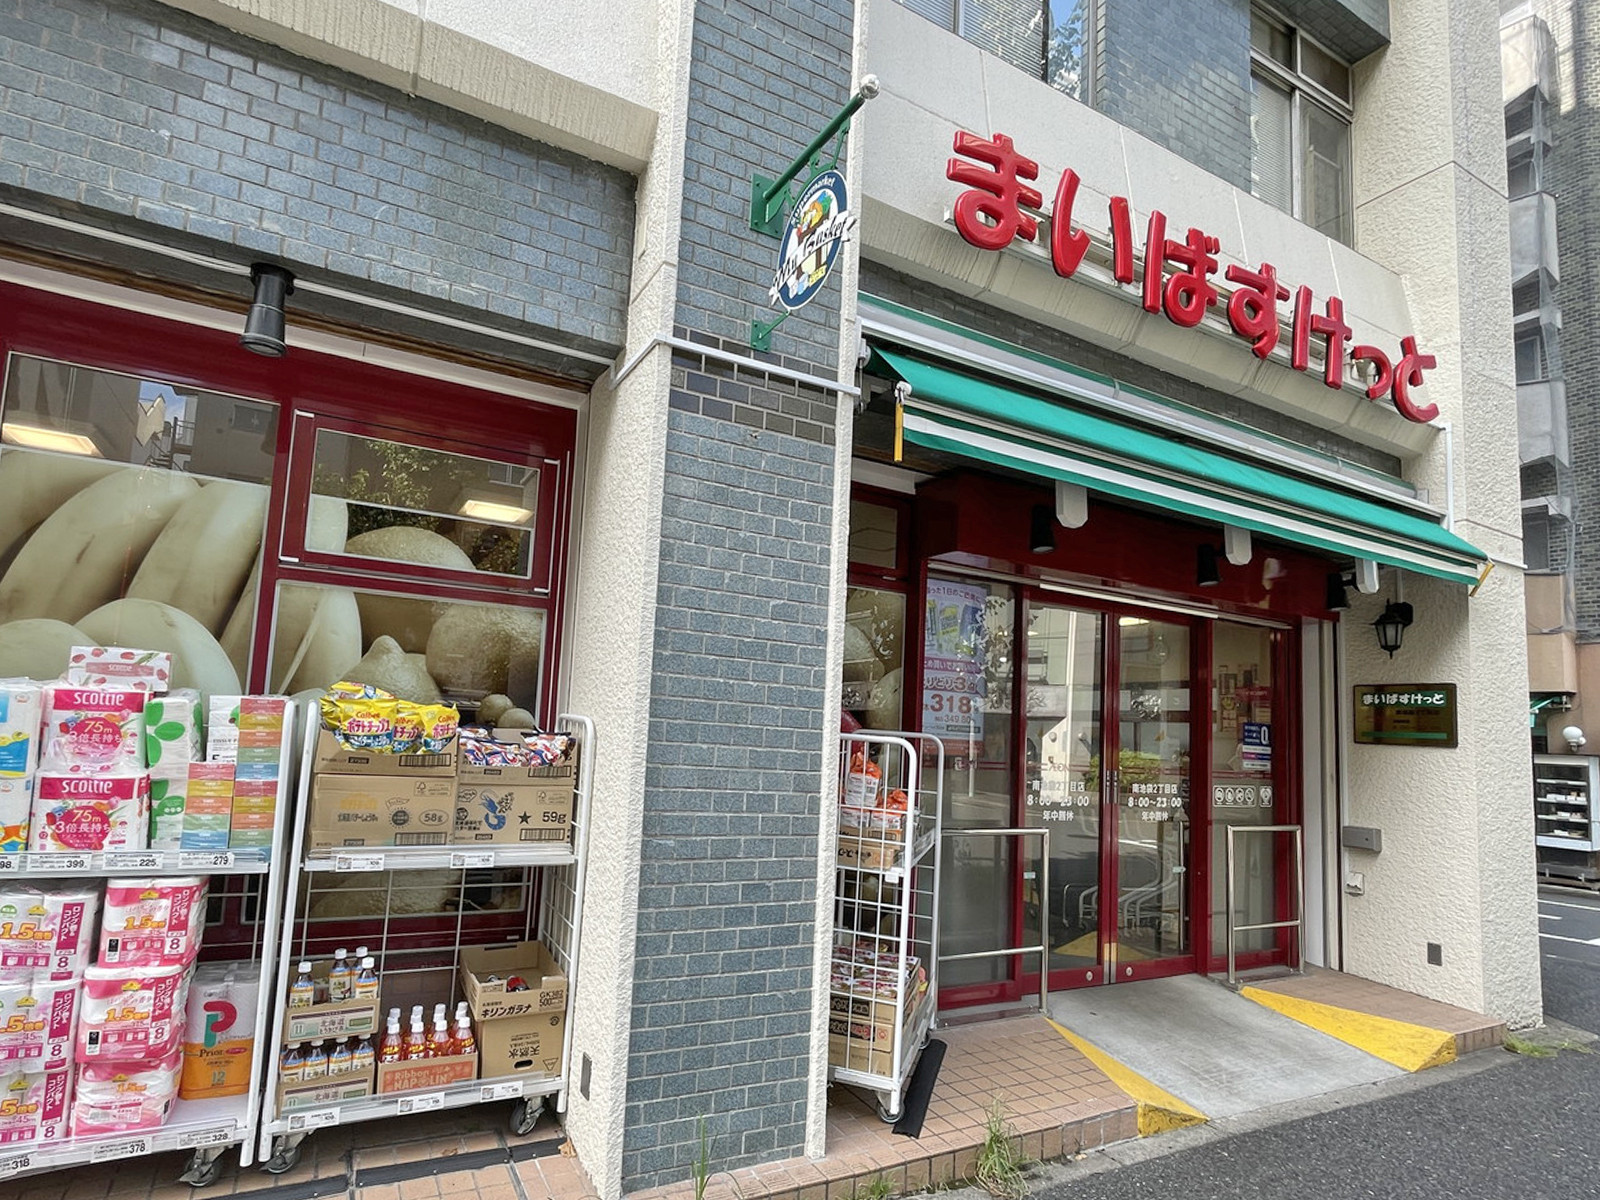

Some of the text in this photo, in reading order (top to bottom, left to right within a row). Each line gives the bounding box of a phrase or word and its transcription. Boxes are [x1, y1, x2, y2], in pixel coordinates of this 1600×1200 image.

[946, 130, 1439, 424] まいばすけっと
[73, 692, 125, 706] scottie
[930, 694, 972, 714] 318
[1363, 693, 1445, 705] まいばすけっと
[61, 780, 113, 794] scottie
[72, 810, 102, 822] 75m
[424, 813, 443, 822] 58g
[542, 811, 567, 824] 59g
[55, 822, 111, 834] 3倍長持ち
[0, 860, 12, 869] 98
[66, 860, 85, 868] 399
[139, 858, 157, 867] 225
[213, 856, 229, 865] 279
[61, 909, 72, 941] コンパクト
[169, 938, 180, 950] 8
[57, 956, 68, 968] 8
[53, 998, 62, 1029] コンパクト
[481, 1004, 532, 1018] キリンガラナ
[0, 1015, 46, 1034] .5倍巻
[154, 1028, 164, 1040] 8
[51, 1044, 62, 1056] 8
[199, 1049, 225, 1057] Prior
[395, 1069, 430, 1080] Ribbon
[46, 1079, 56, 1111] コンパクト
[44, 1126, 55, 1138] 8
[212, 1132, 229, 1142] 328
[129, 1142, 146, 1153] 378
[11, 1158, 30, 1169] 318
